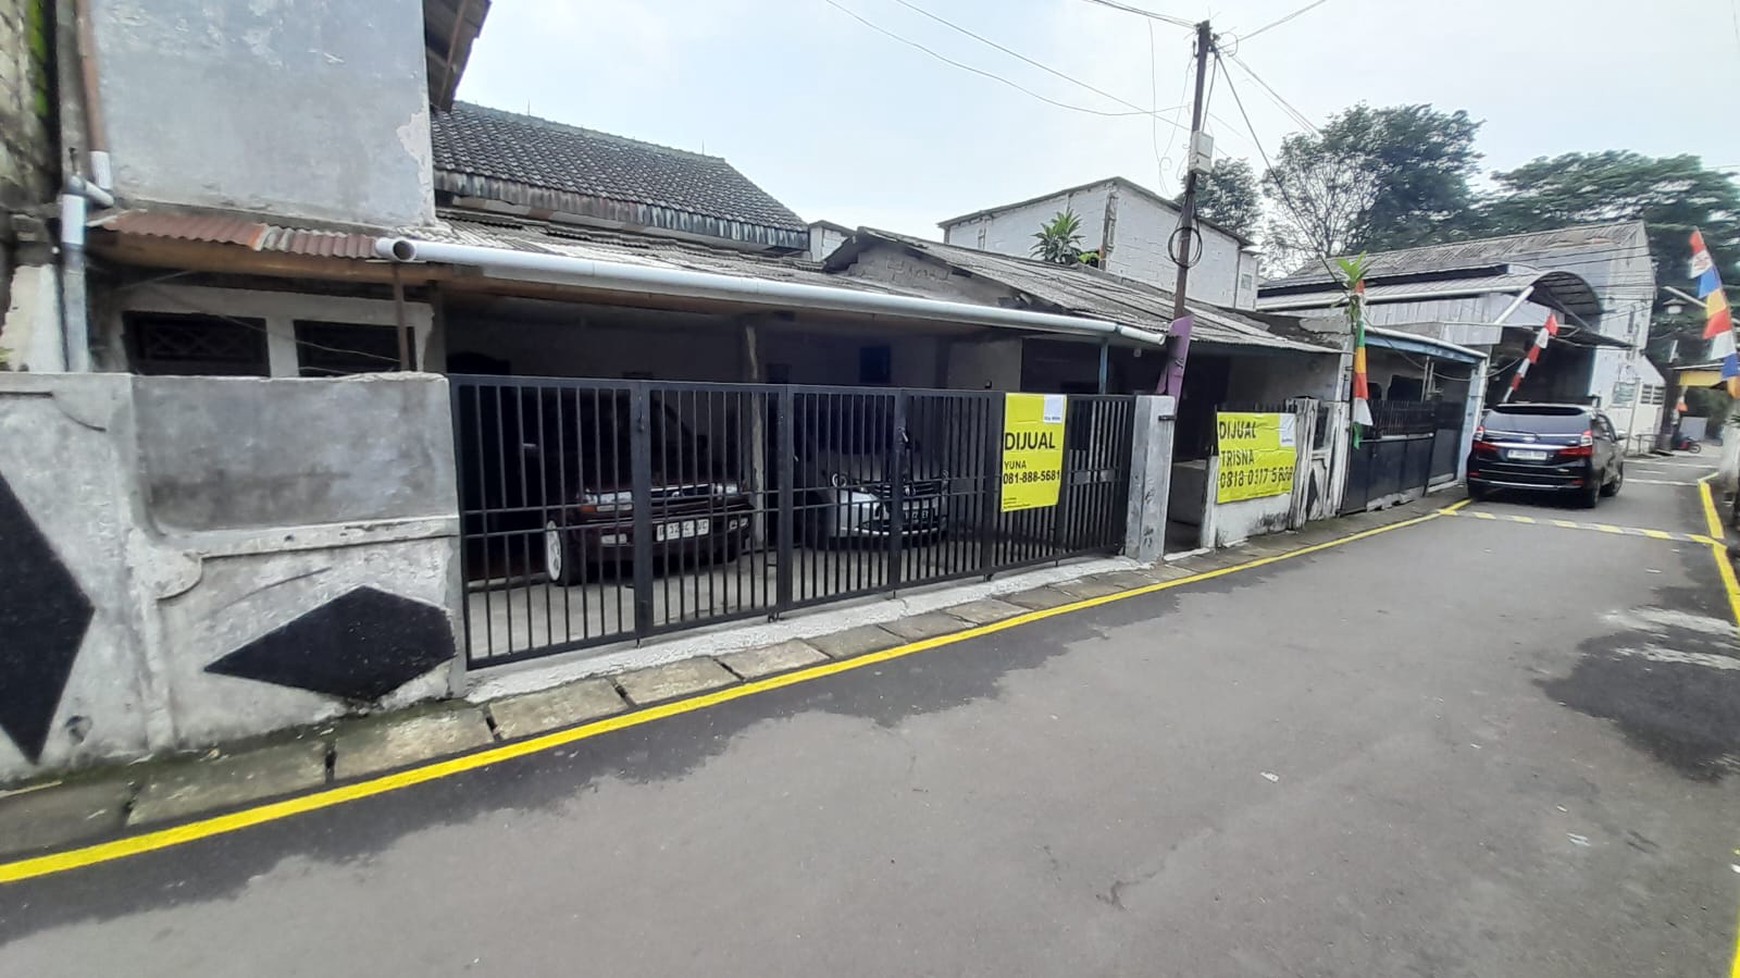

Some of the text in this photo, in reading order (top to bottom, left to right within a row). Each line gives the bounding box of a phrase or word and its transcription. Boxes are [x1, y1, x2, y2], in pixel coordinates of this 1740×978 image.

[1219, 421, 1256, 440] DIJUAL
[1004, 432, 1056, 450] DIJUAL
[1004, 460, 1027, 470] YUNA
[1221, 449, 1255, 467] TRISNA
